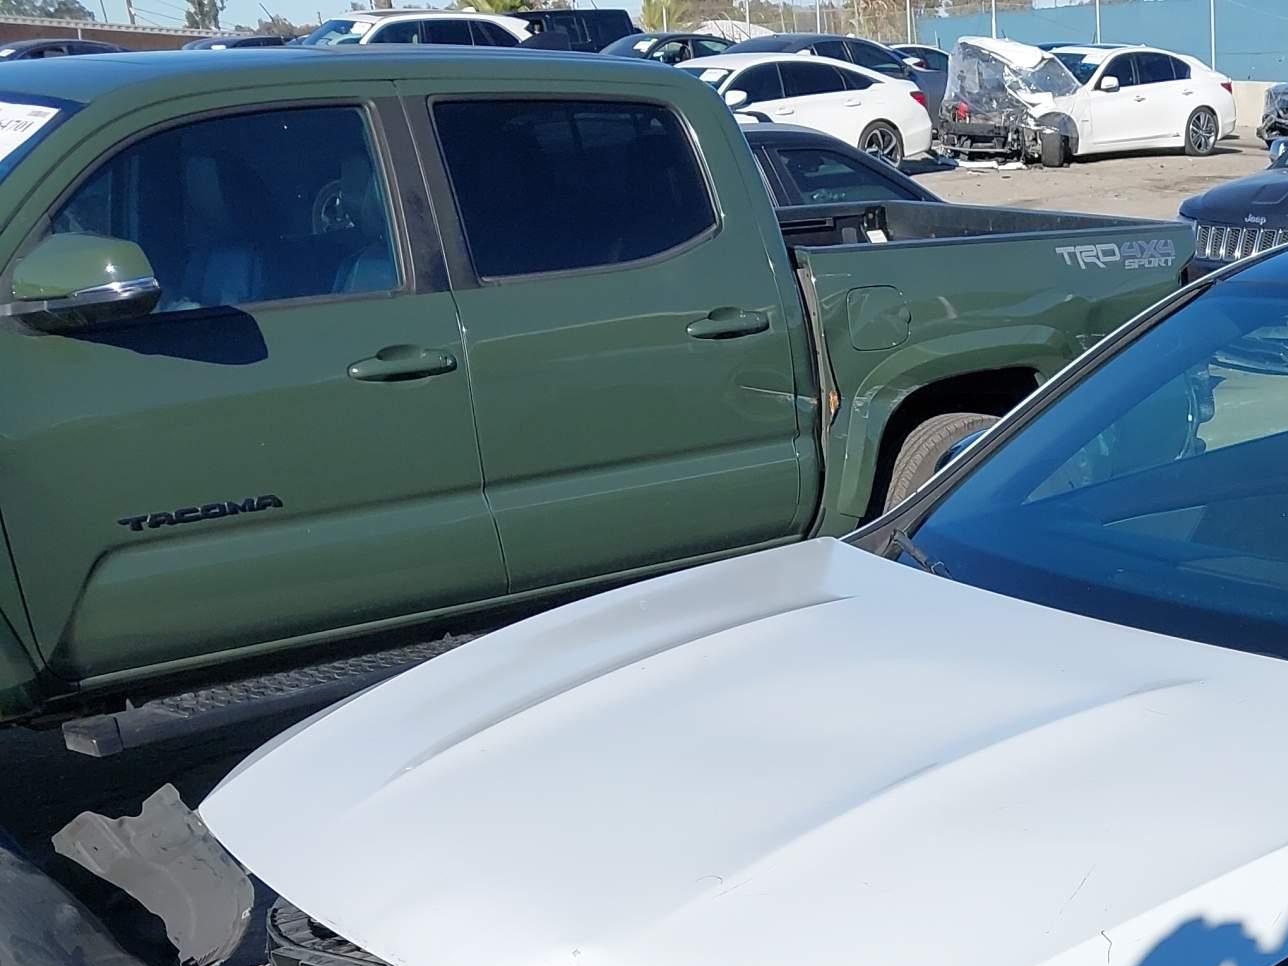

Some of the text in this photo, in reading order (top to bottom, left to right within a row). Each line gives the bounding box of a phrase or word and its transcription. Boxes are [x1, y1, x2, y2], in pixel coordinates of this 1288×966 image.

[1244, 213, 1267, 226] Jeep
[1055, 243, 1120, 270] TRD
[1124, 256, 1176, 269] SPORT
[117, 494, 284, 532] TACOMA
